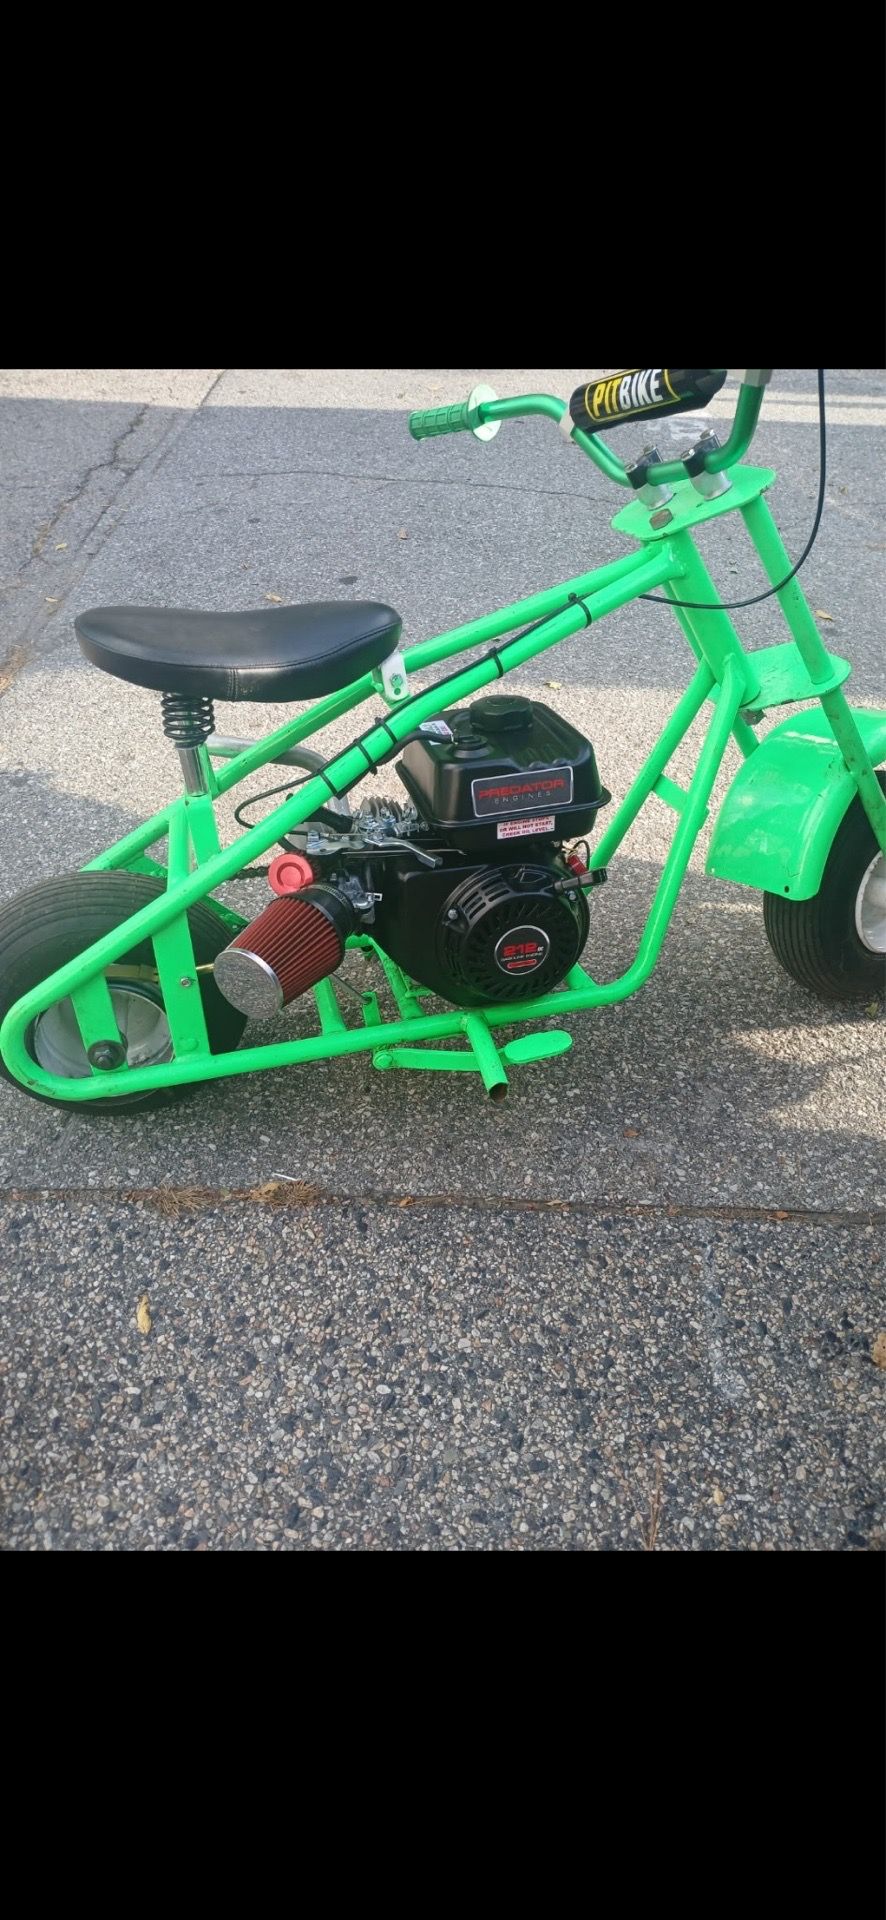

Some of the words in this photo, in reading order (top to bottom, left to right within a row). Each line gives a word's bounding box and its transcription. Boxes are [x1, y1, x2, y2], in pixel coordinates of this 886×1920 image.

[592, 369, 663, 417] PITBIKE
[478, 779, 564, 799] PREDATOR
[494, 790, 551, 804] ENGINES
